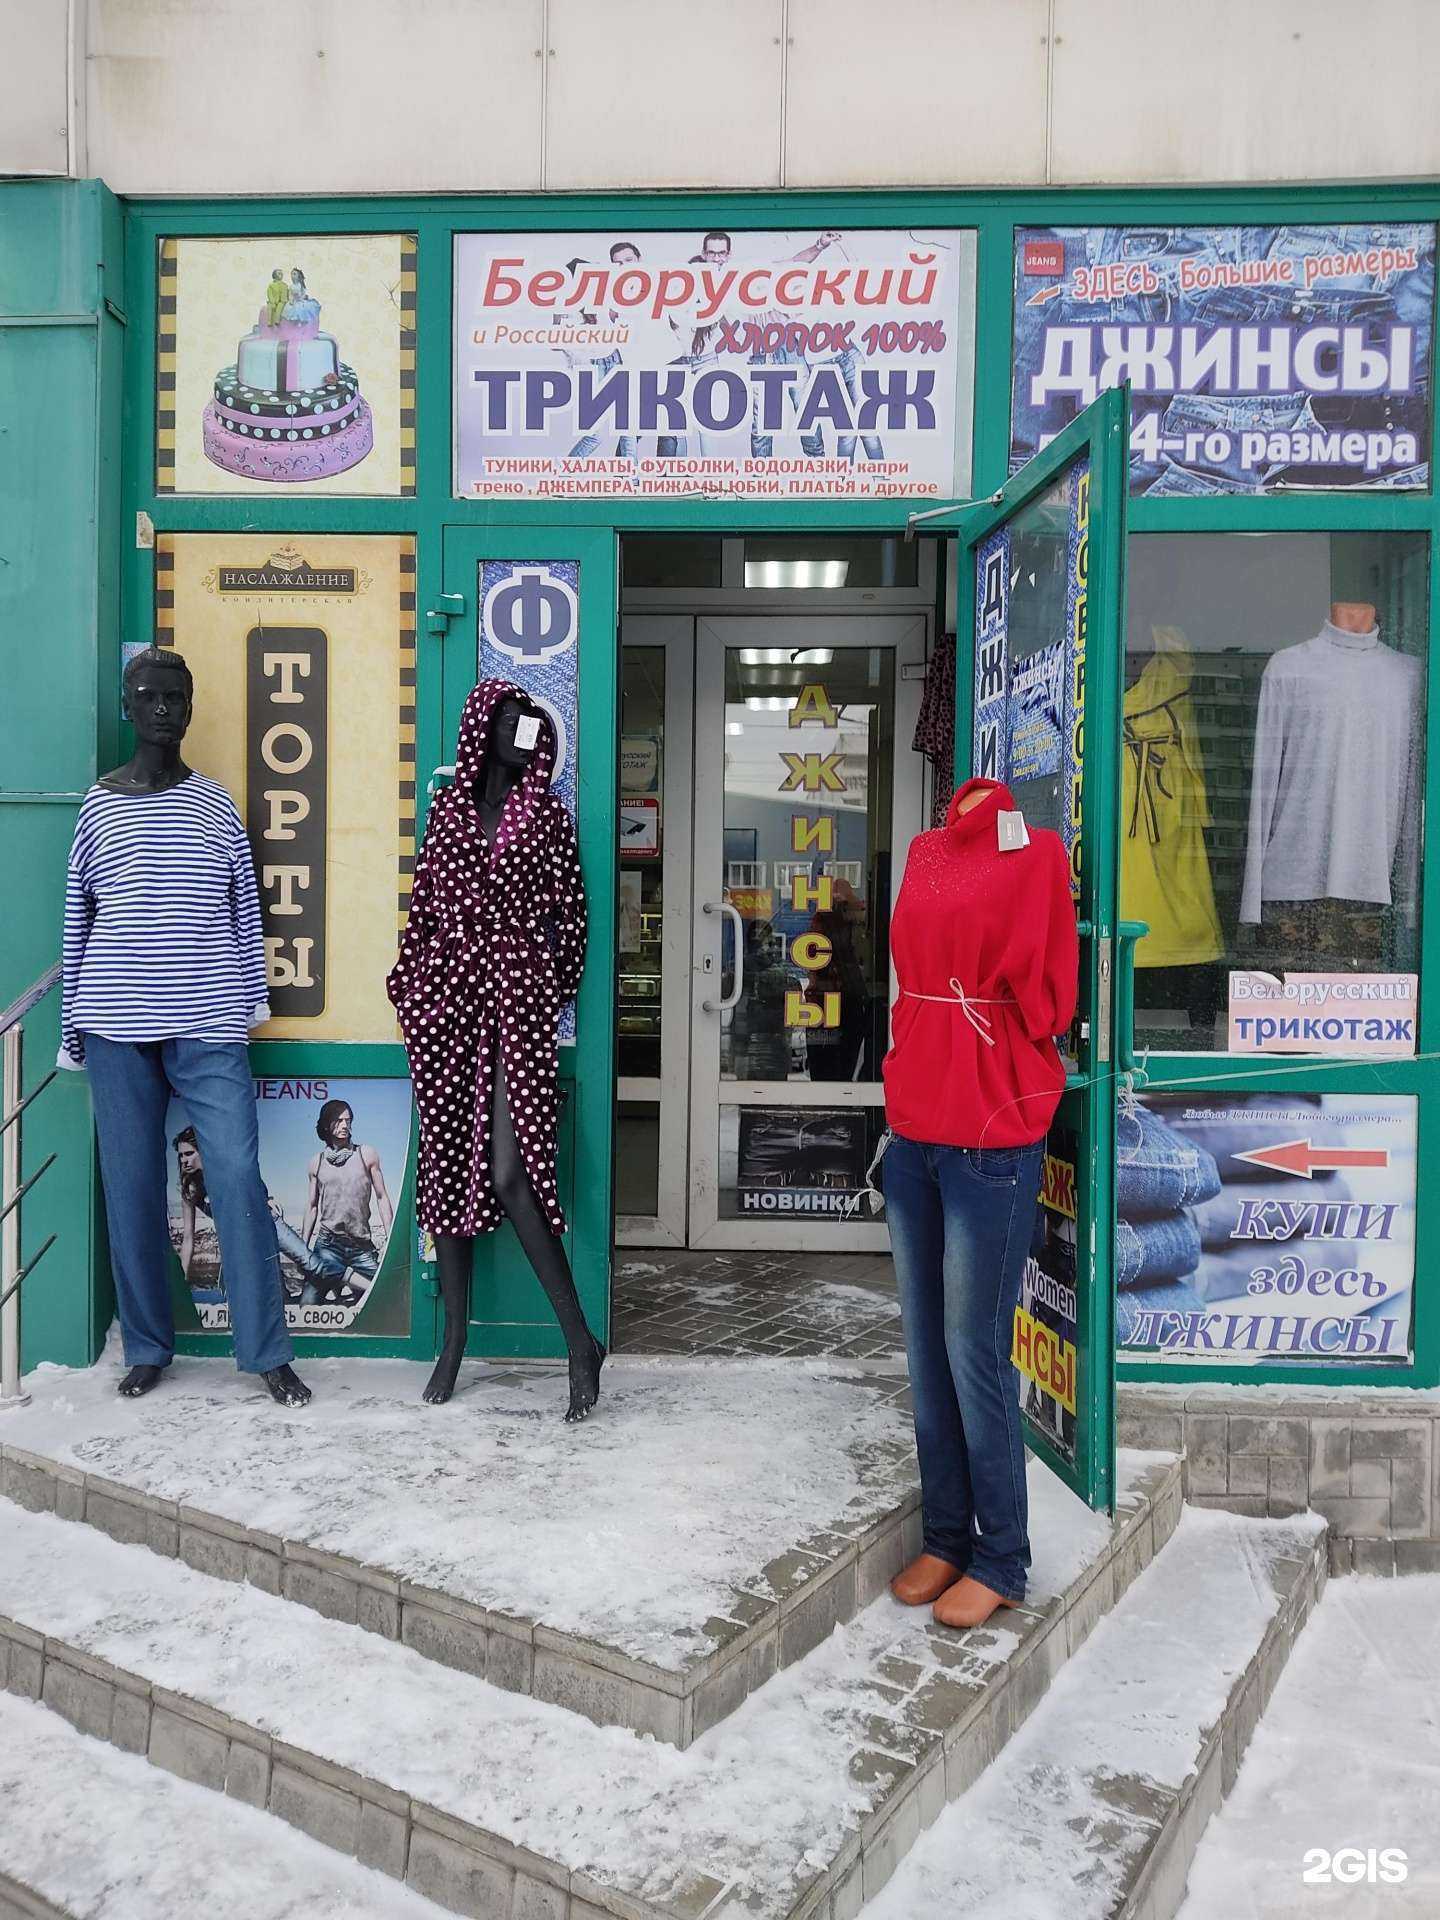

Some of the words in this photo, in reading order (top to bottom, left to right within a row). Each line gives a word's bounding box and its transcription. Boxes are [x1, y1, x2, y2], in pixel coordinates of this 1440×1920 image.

[482, 252, 938, 319] Белорусский
[1073, 264, 1157, 300] ЗДЕСЬ
[1180, 259, 1292, 289] Большие
[1305, 247, 1417, 286] размеры
[473, 331, 486, 344] и
[494, 325, 630, 345] Российский
[715, 320, 855, 355] ХЛОПОК
[863, 320, 946, 355] 100%
[1031, 327, 1411, 405] ДЖИНСЫ
[474, 369, 936, 431] ТРИКОТАЖ
[1130, 413, 1231, 463] 4-го
[1241, 432, 1416, 470] размера
[485, 460, 557, 475] ТУНИКИ,
[562, 460, 636, 475] ХАЛАТЫ,
[641, 460, 739, 475] ФУТБОЛКИ,
[744, 460, 853, 475] ВОДОЛАЗКИ,
[857, 463, 909, 476] капри
[536, 480, 637, 495] ДЖЕМПЕРА,
[789, 480, 855, 493] ПЛАТЬЯ
[861, 484, 870, 493] и
[875, 484, 937, 497] другое
[224, 573, 348, 586] НАСЛАЖДЕНИЕ
[261, 652, 315, 988] ТОРТЫ
[778, 683, 848, 1028] ДЖИНСЫ
[1235, 1016, 1413, 1041] трикотаж
[254, 1080, 328, 1100] JEANS
[743, 1192, 860, 1211] НОВИНКИ
[1231, 1199, 1399, 1240] КУПИ
[1025, 1258, 1076, 1323] Women
[1247, 1256, 1387, 1298] здесь
[304, 1311, 345, 1324] СВОЮ
